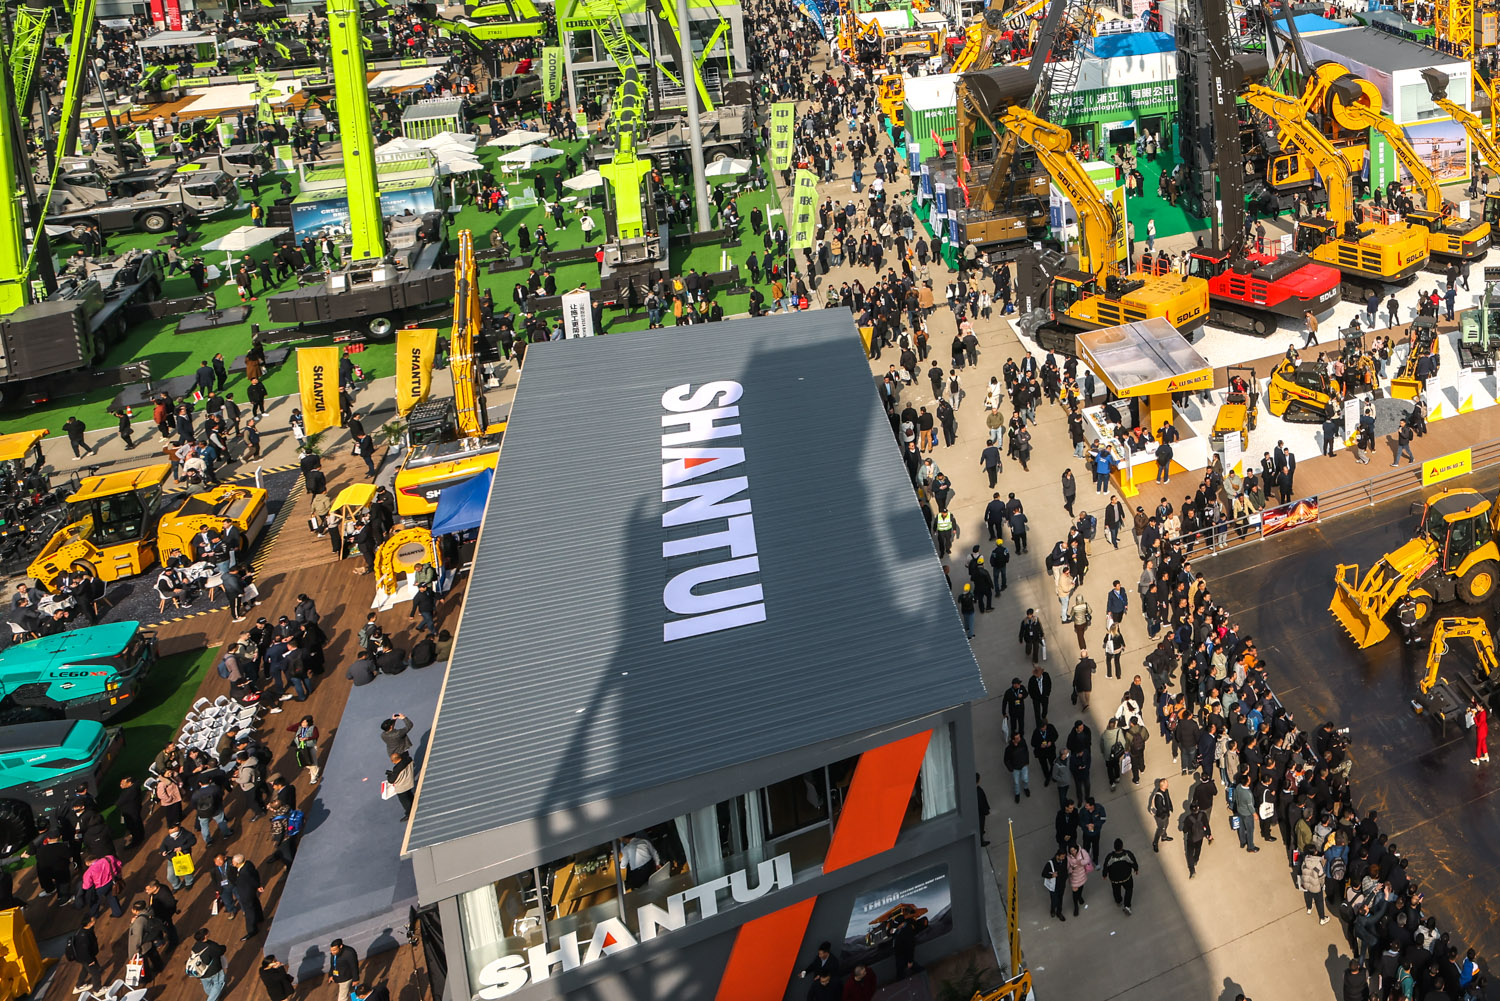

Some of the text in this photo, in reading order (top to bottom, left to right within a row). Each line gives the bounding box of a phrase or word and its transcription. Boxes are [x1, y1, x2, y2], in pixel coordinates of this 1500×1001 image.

[548, 52, 557, 97] ZOOMLION
[1215, 76, 1224, 105] SDLG
[1293, 131, 1315, 154] SDLG
[1394, 144, 1412, 167] SDLG
[1057, 171, 1079, 199] SDLG
[1406, 250, 1425, 264] SDLG
[1319, 287, 1339, 304] SDLG
[1176, 308, 1200, 324] SDLG
[412, 348, 422, 398] SHANTUI
[313, 365, 326, 413] SHANTUI
[661, 380, 767, 643] SHANTUI
[477, 852, 794, 1001] SHANTUI
